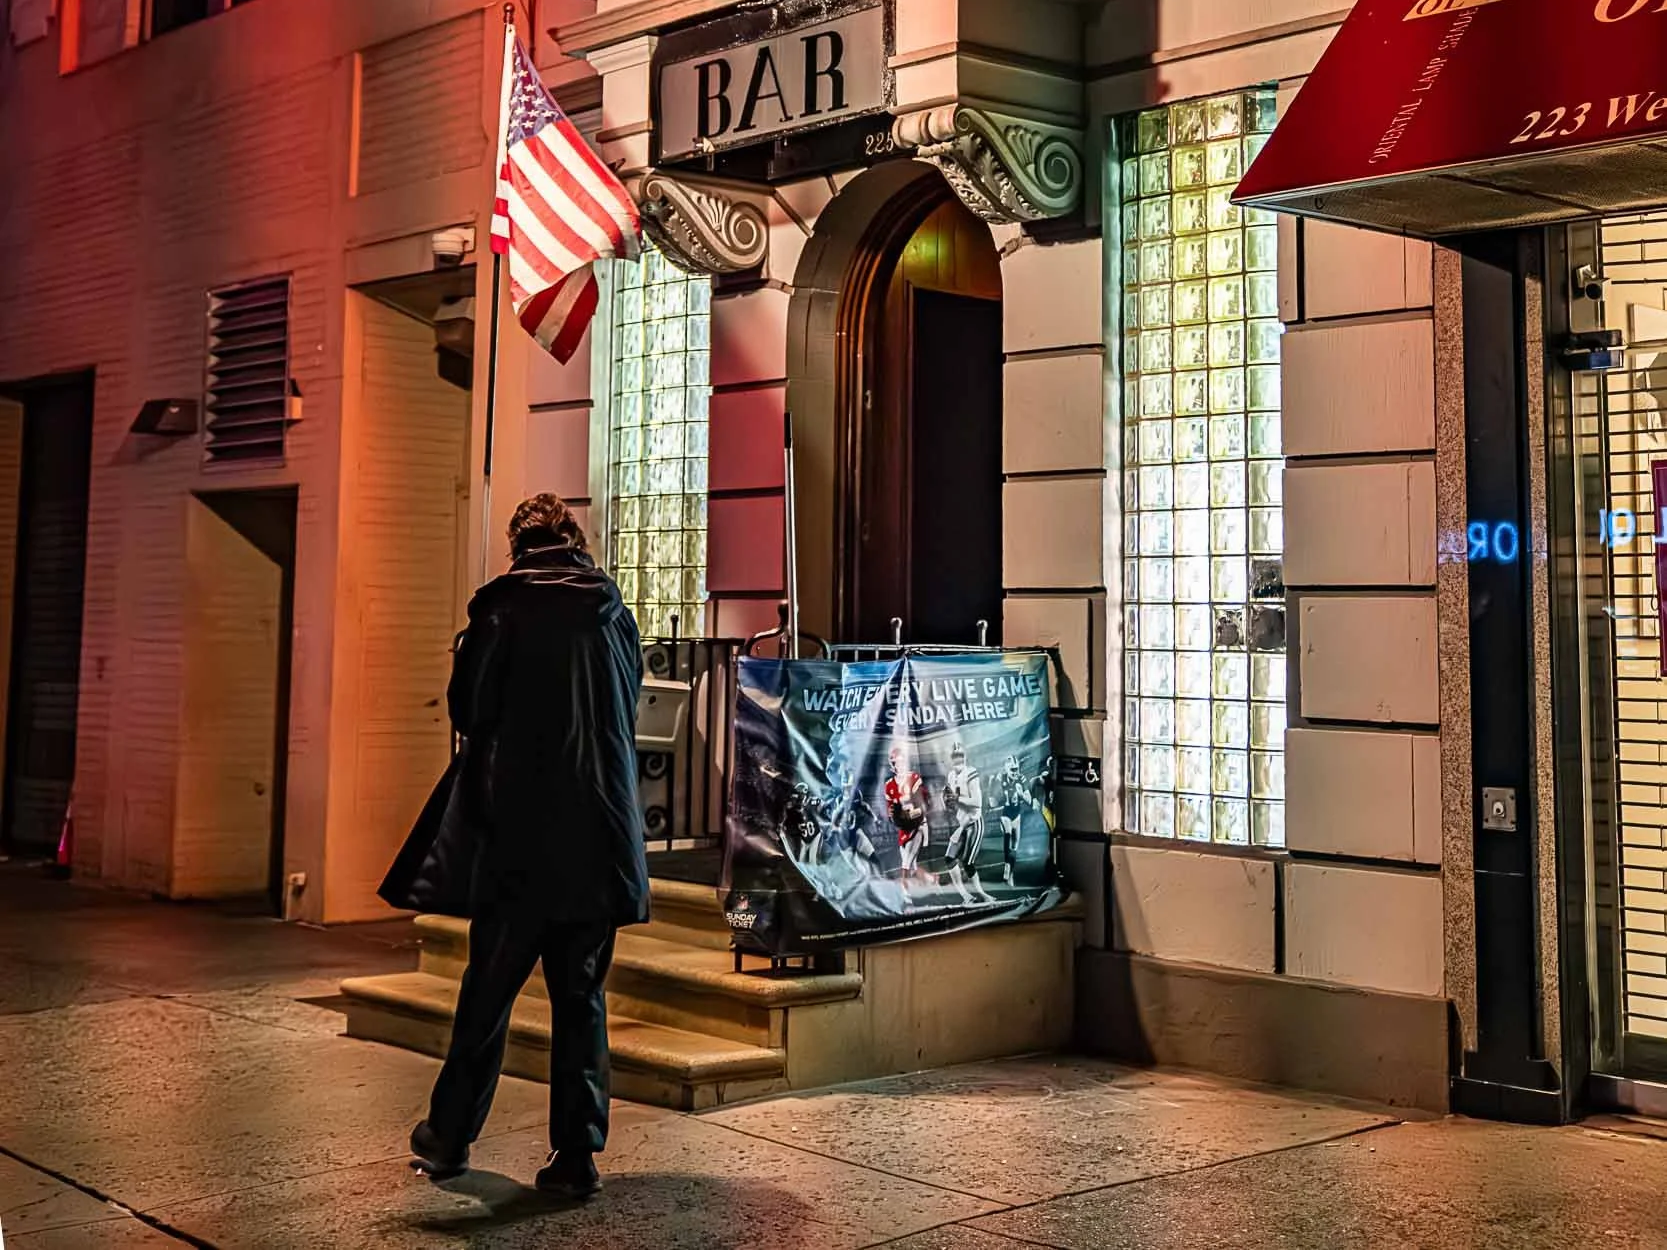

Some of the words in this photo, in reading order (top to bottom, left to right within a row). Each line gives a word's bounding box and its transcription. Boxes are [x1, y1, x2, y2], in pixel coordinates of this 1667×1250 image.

[693, 29, 849, 140] BAR
[1367, 97, 1423, 165] ORIENTAL
[1411, 56, 1448, 93] LAMP
[1508, 102, 1592, 144] 223
[865, 131, 894, 156] 225
[803, 685, 861, 712] WATCH
[930, 677, 979, 701] LIVE
[982, 674, 1042, 698] GAME
[886, 704, 957, 726] SUNDAY
[962, 701, 1008, 721] HERE
[726, 912, 757, 922] SUNDAY
